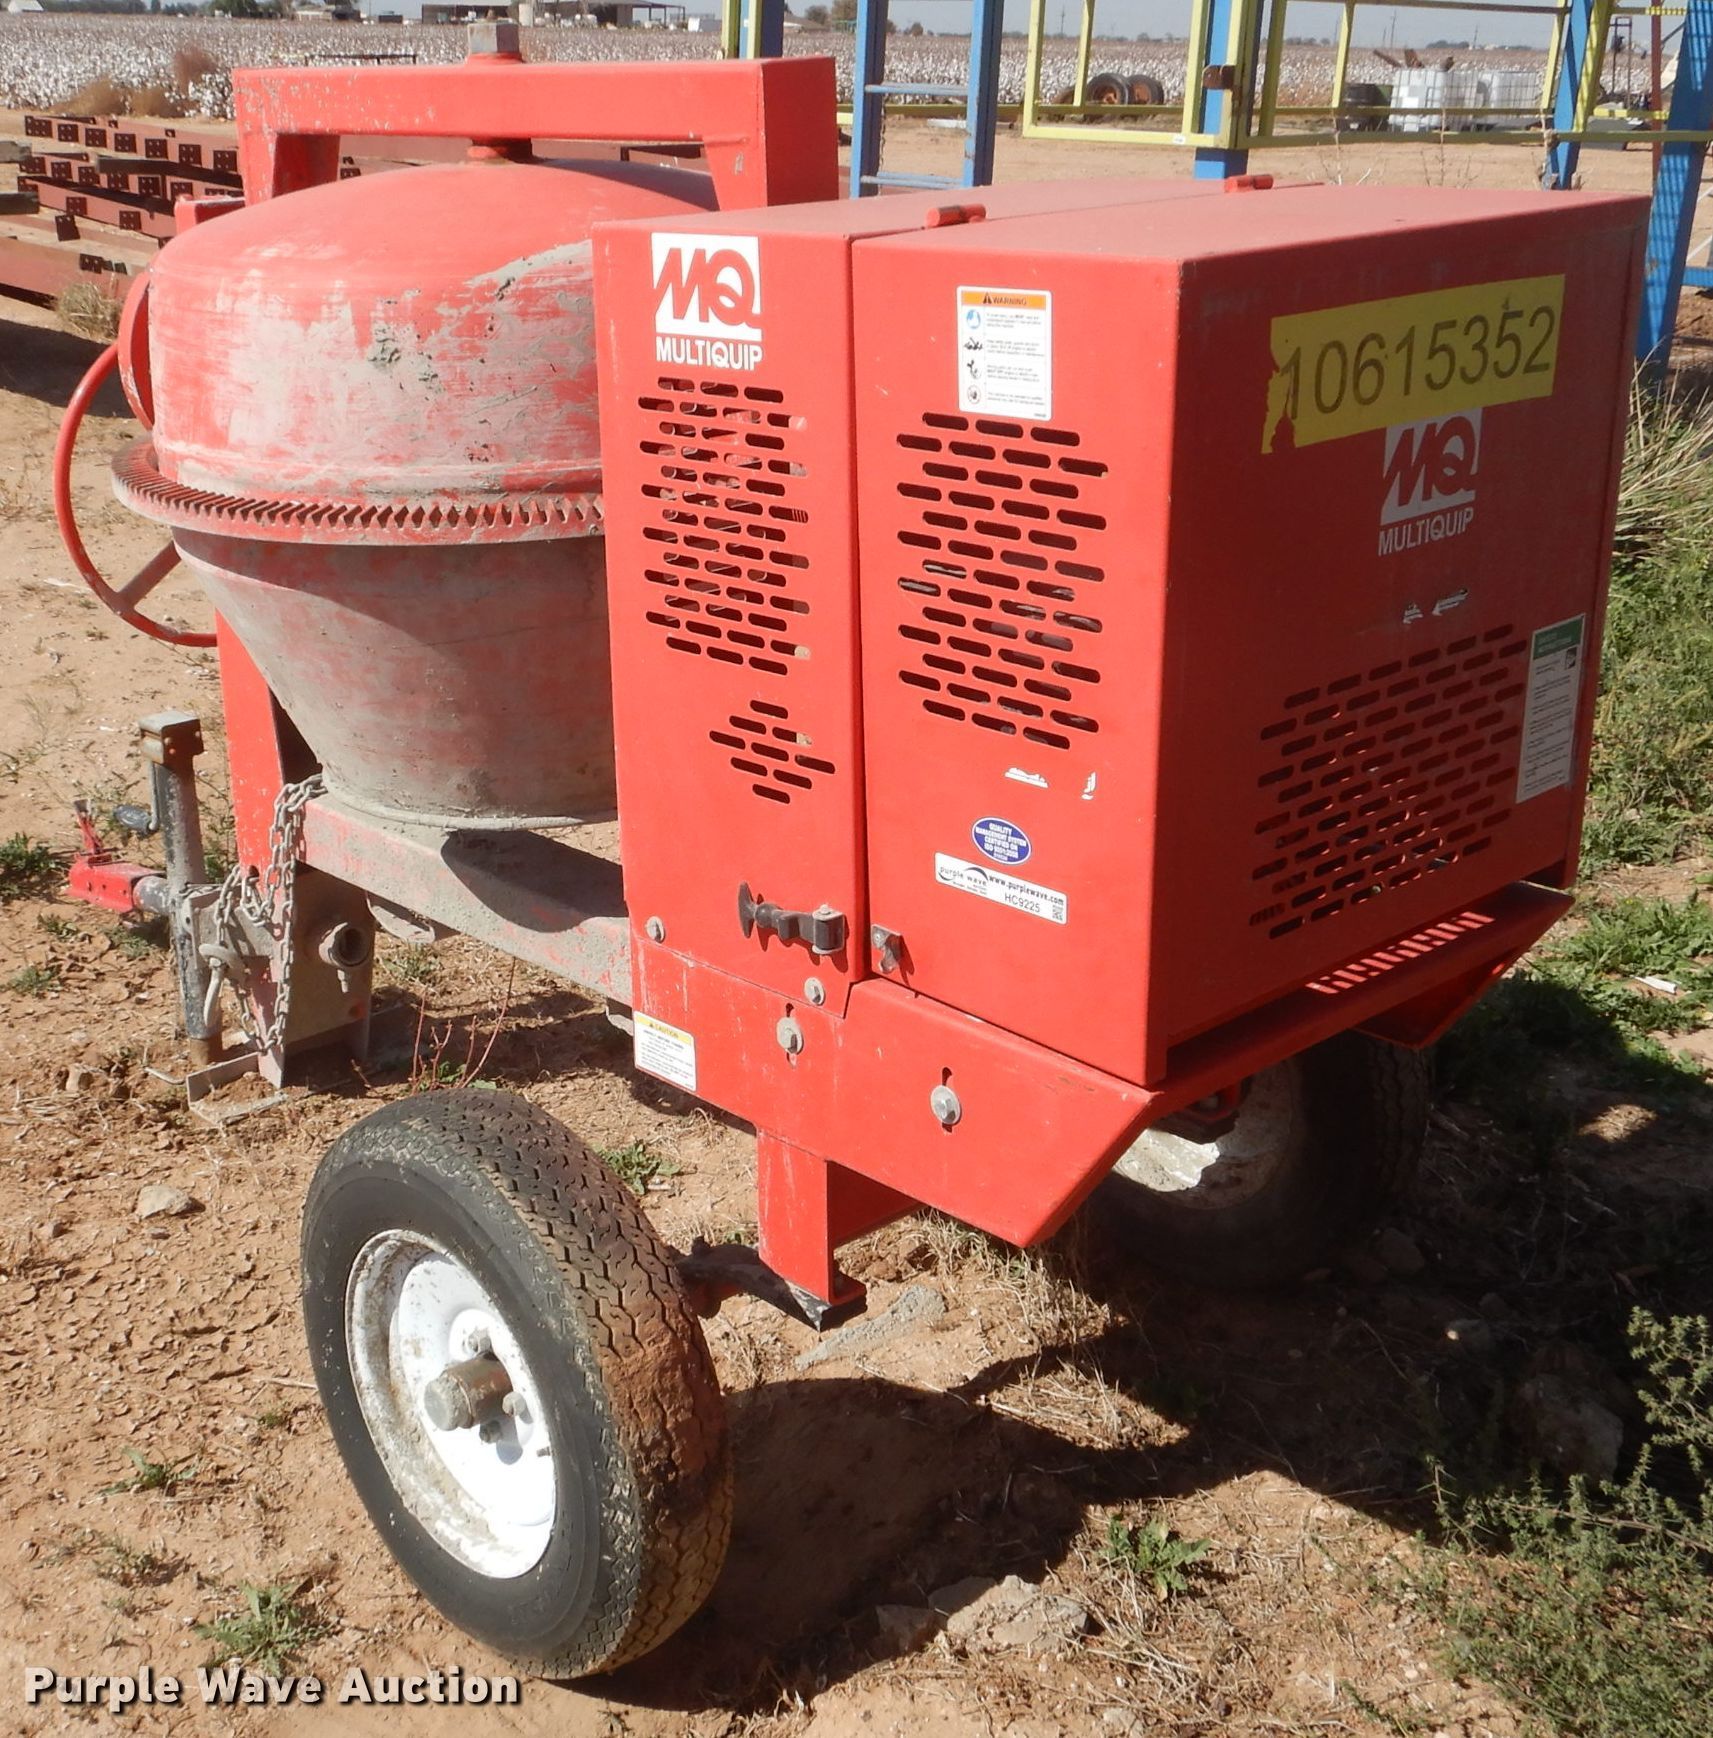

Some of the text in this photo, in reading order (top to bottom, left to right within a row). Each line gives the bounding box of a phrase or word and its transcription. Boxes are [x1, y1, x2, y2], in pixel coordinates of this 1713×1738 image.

[653, 247, 761, 328] MQ
[993, 295, 1027, 306] WARNING
[655, 335, 763, 371] MULTIQUIP
[1280, 305, 1556, 421] 10615352
[1383, 415, 1477, 508] MQ
[1377, 506, 1475, 557] MULTIQUIP
[989, 822, 1012, 837] QUALITY
[940, 866, 987, 886] purple wave
[988, 875, 1064, 906] www.purplewave.com
[1004, 893, 1041, 913] HC9225
